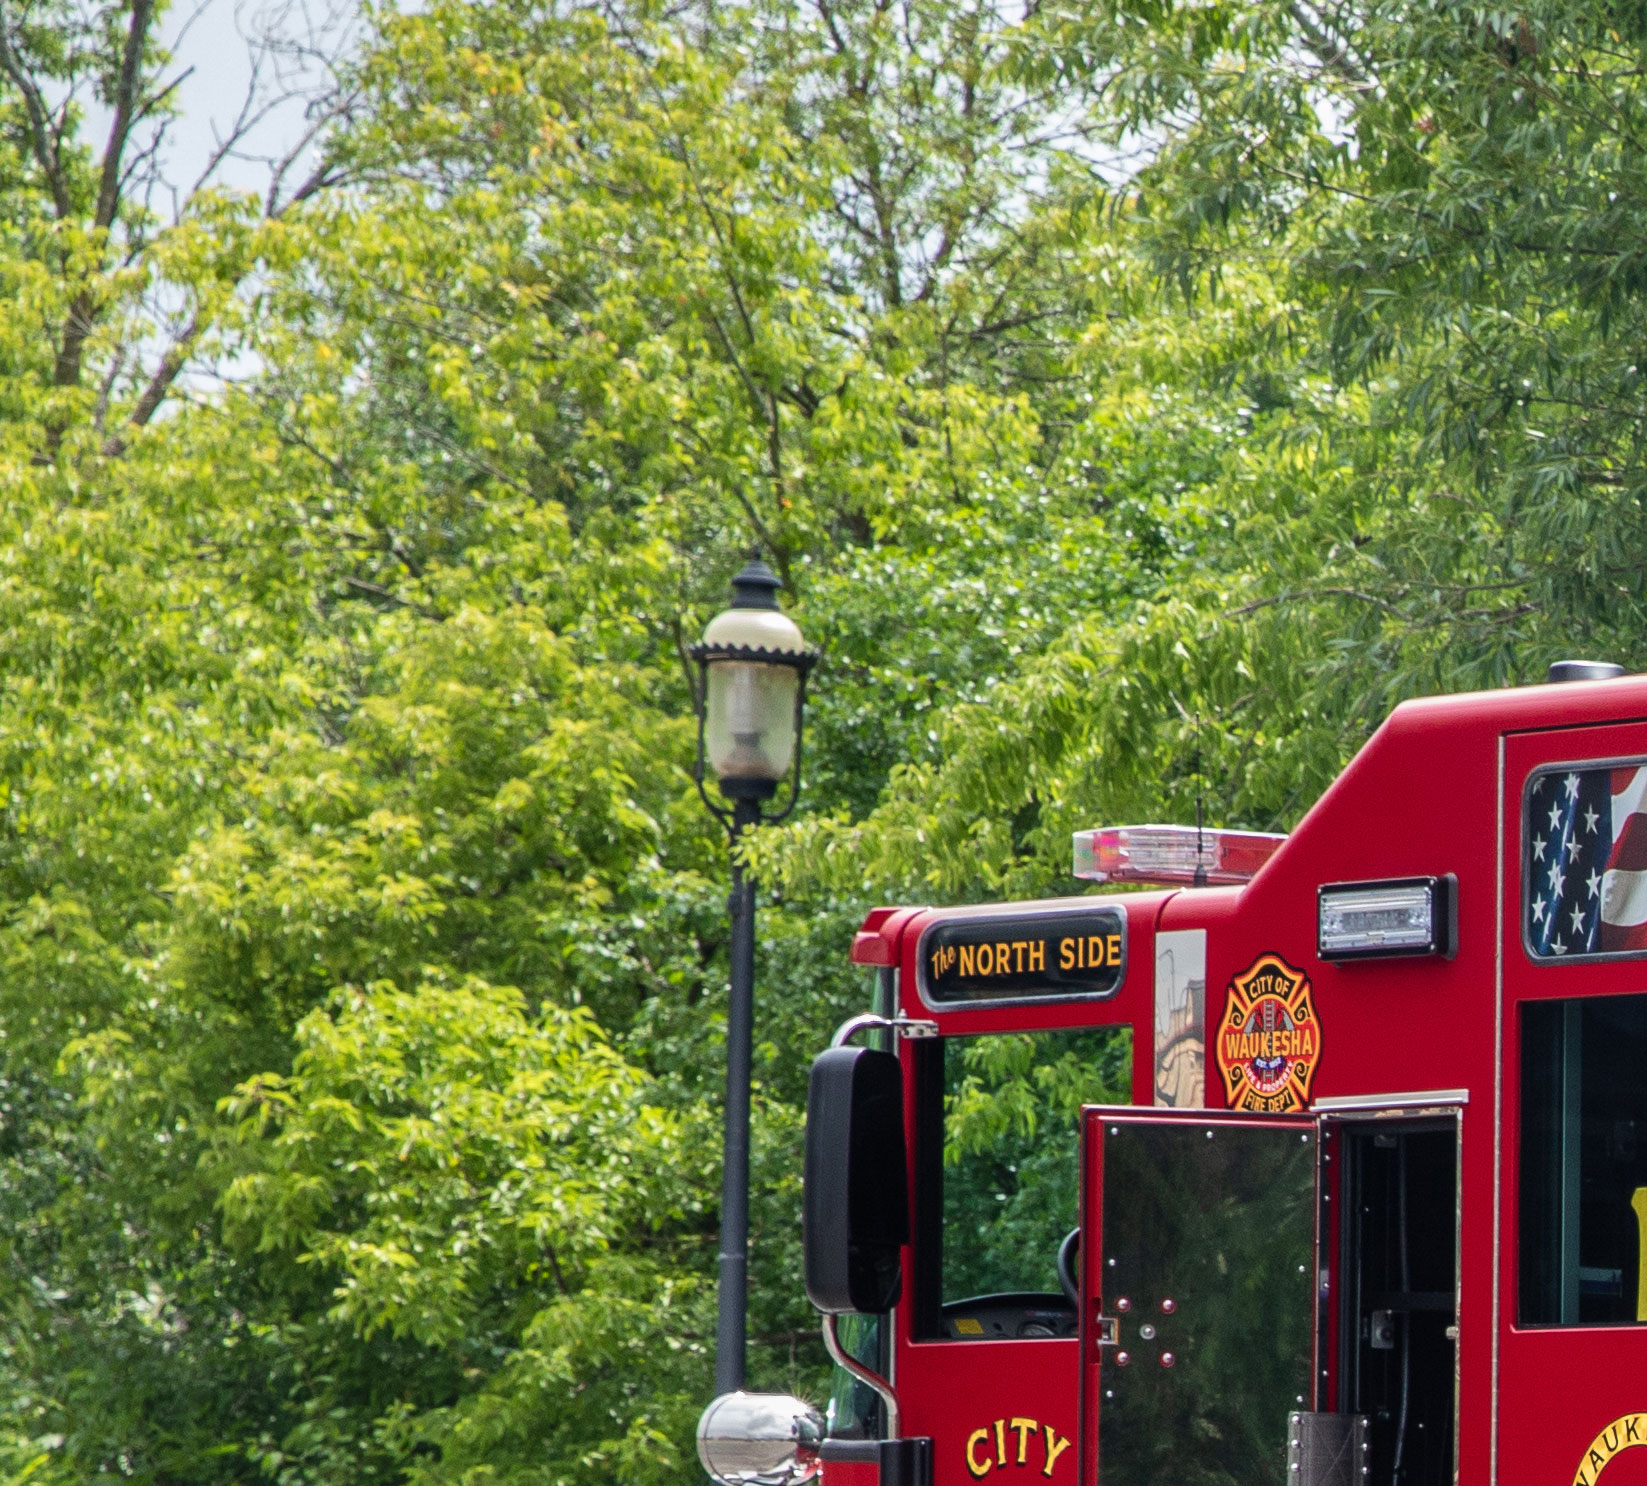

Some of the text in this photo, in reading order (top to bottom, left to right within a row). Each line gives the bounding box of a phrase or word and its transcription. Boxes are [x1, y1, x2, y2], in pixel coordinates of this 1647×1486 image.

[931, 934, 1122, 981] The NORTH SIDE
[1250, 975, 1291, 999] CITY OF
[1226, 1029, 1313, 1060] WAUKESHA
[1245, 1090, 1290, 1111] FIRE DEPT
[966, 1417, 1071, 1480] CITY
